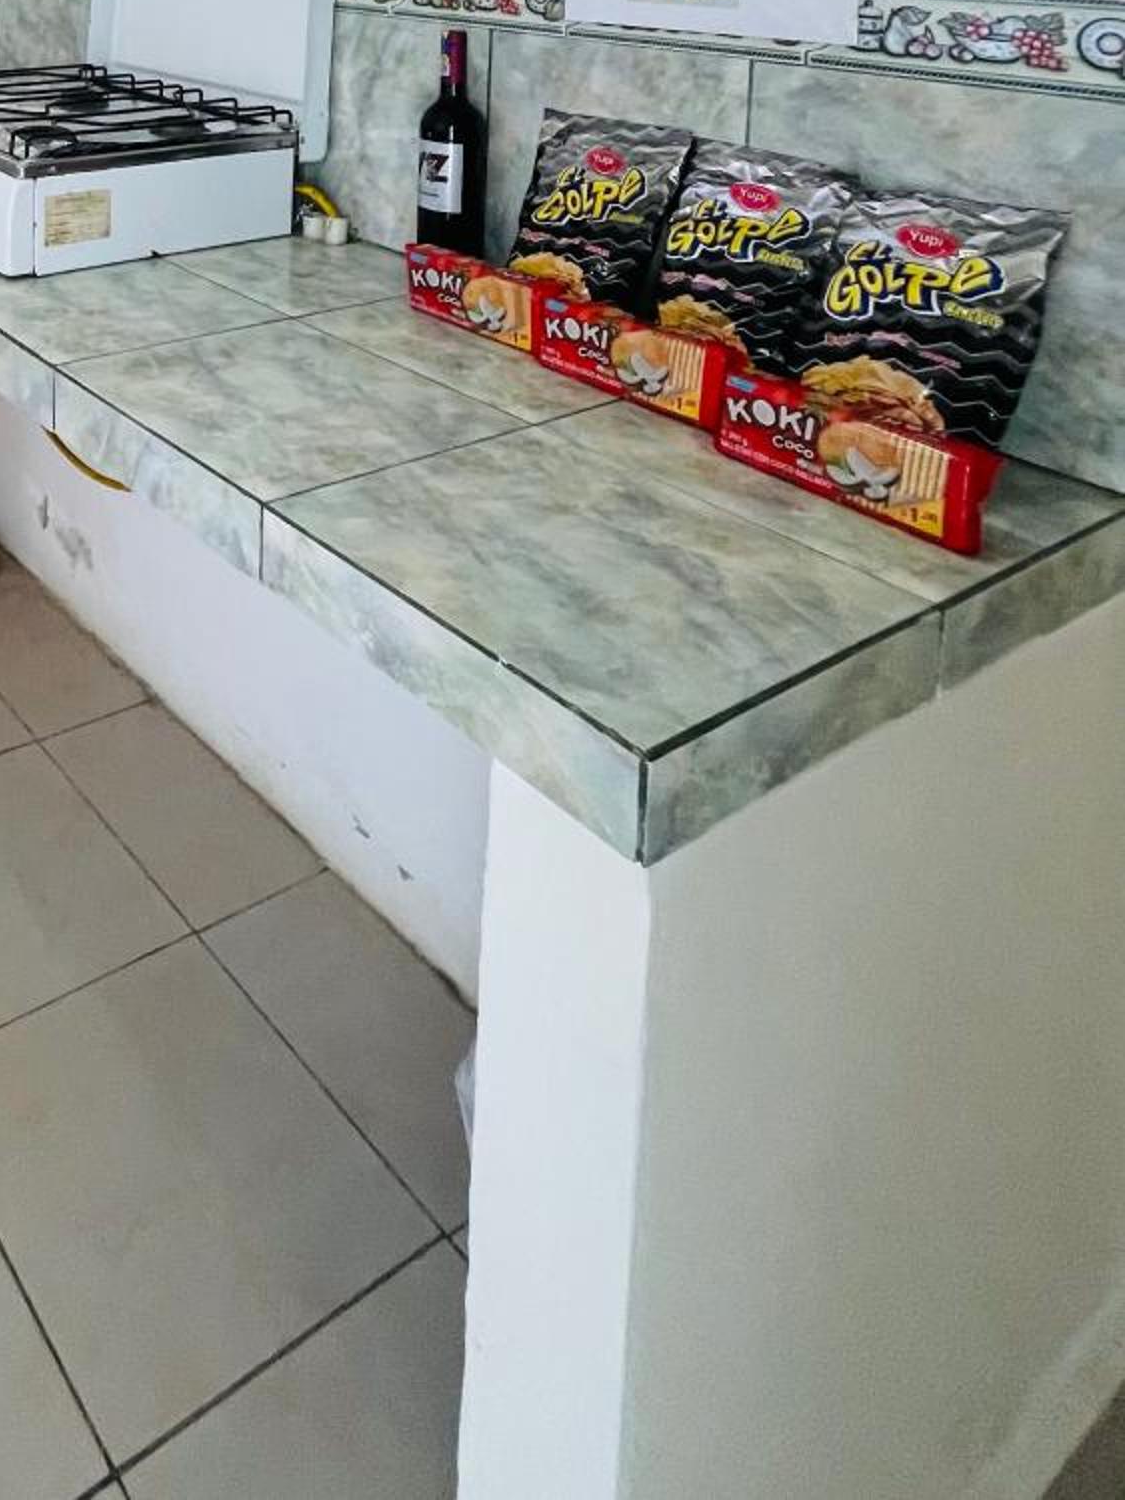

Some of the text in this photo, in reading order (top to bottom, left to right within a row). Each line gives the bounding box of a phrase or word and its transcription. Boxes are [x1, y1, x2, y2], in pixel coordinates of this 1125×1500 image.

[592, 153, 615, 165] Yupi
[739, 187, 766, 202] Yupi
[908, 229, 944, 247] Yupi
[411, 268, 462, 295] KOKI
[545, 317, 609, 350] KOKI
[727, 397, 816, 441] KOKI
